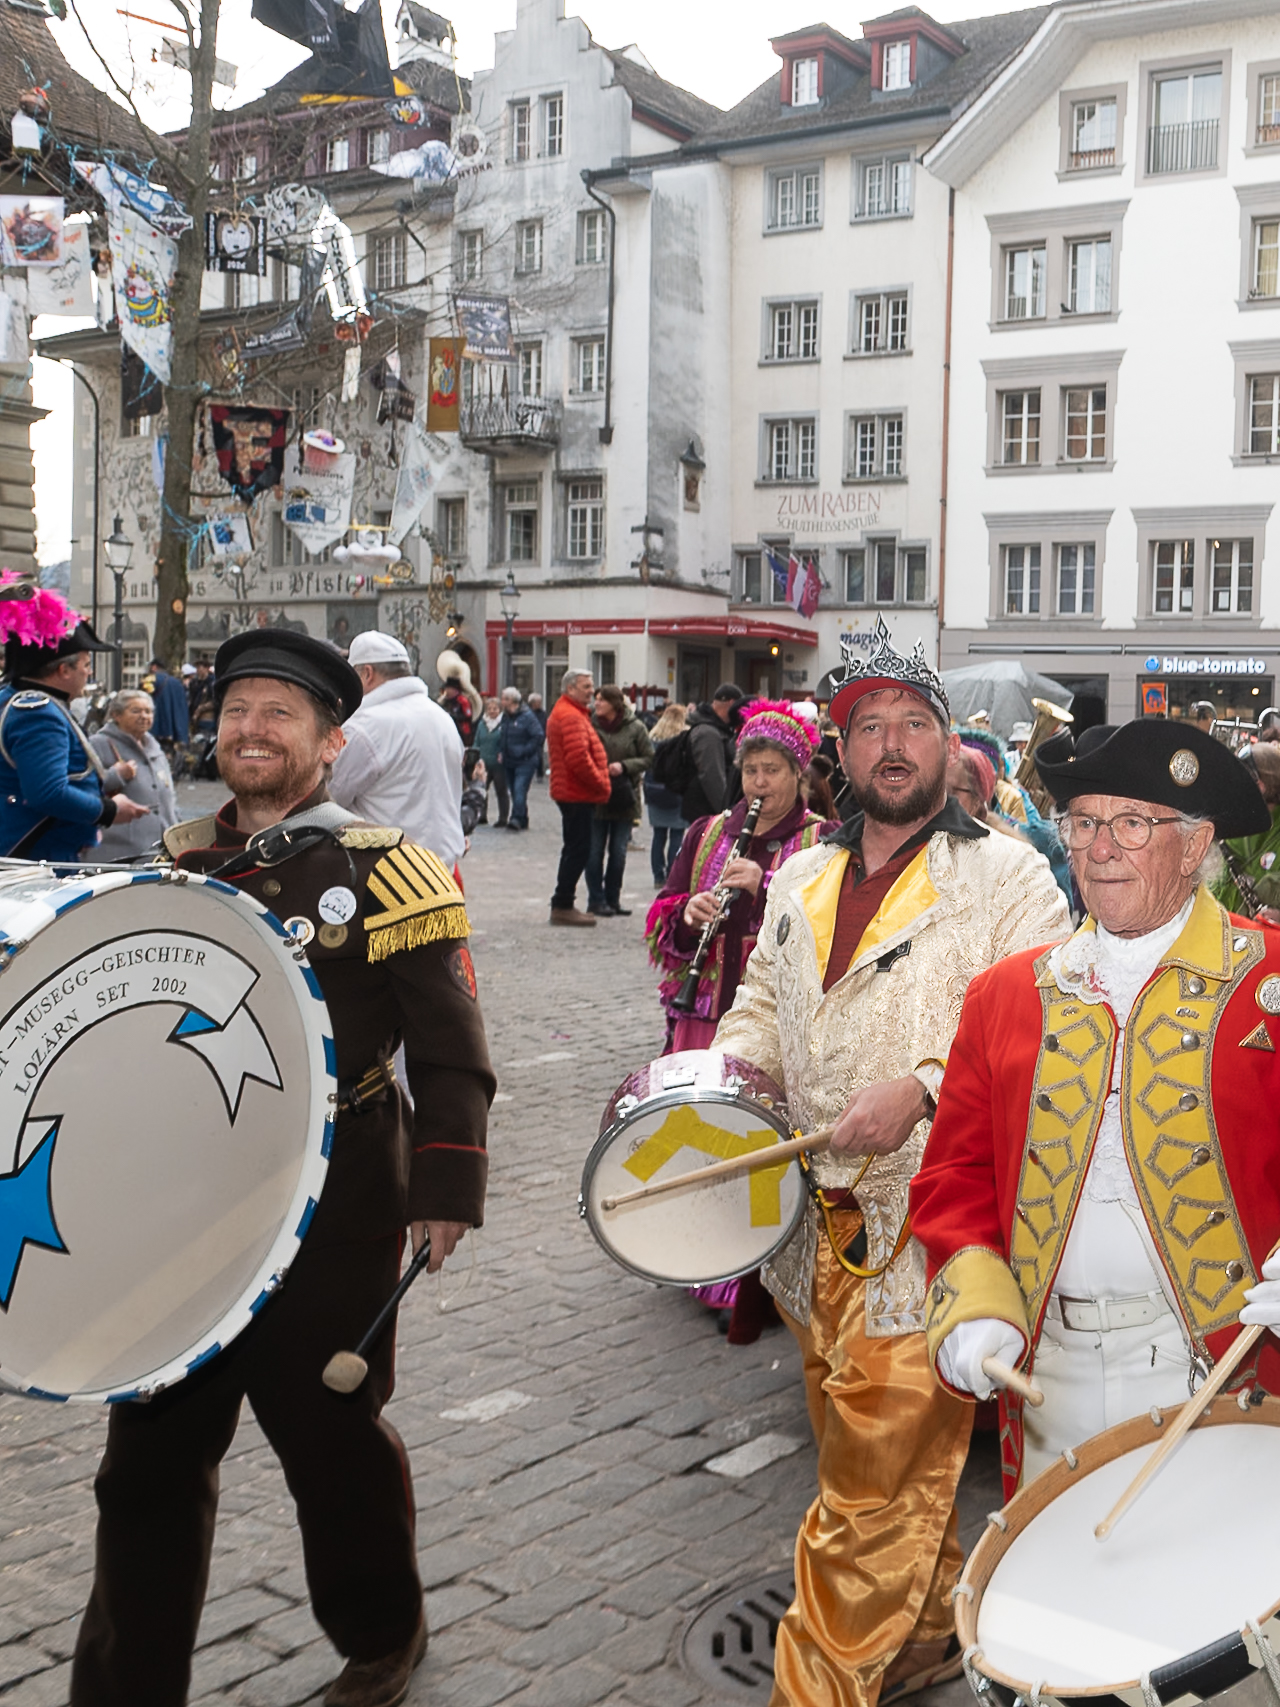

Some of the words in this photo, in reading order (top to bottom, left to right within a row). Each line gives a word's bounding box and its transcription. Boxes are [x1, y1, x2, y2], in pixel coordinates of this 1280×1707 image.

[777, 494, 818, 515] ZUM
[821, 490, 881, 518] RABEN
[1162, 656, 1266, 674] blue-tomato
[13, 1008, 80, 1096] LOZÄRN
[96, 982, 130, 1008] SET
[151, 977, 187, 996] 2002
